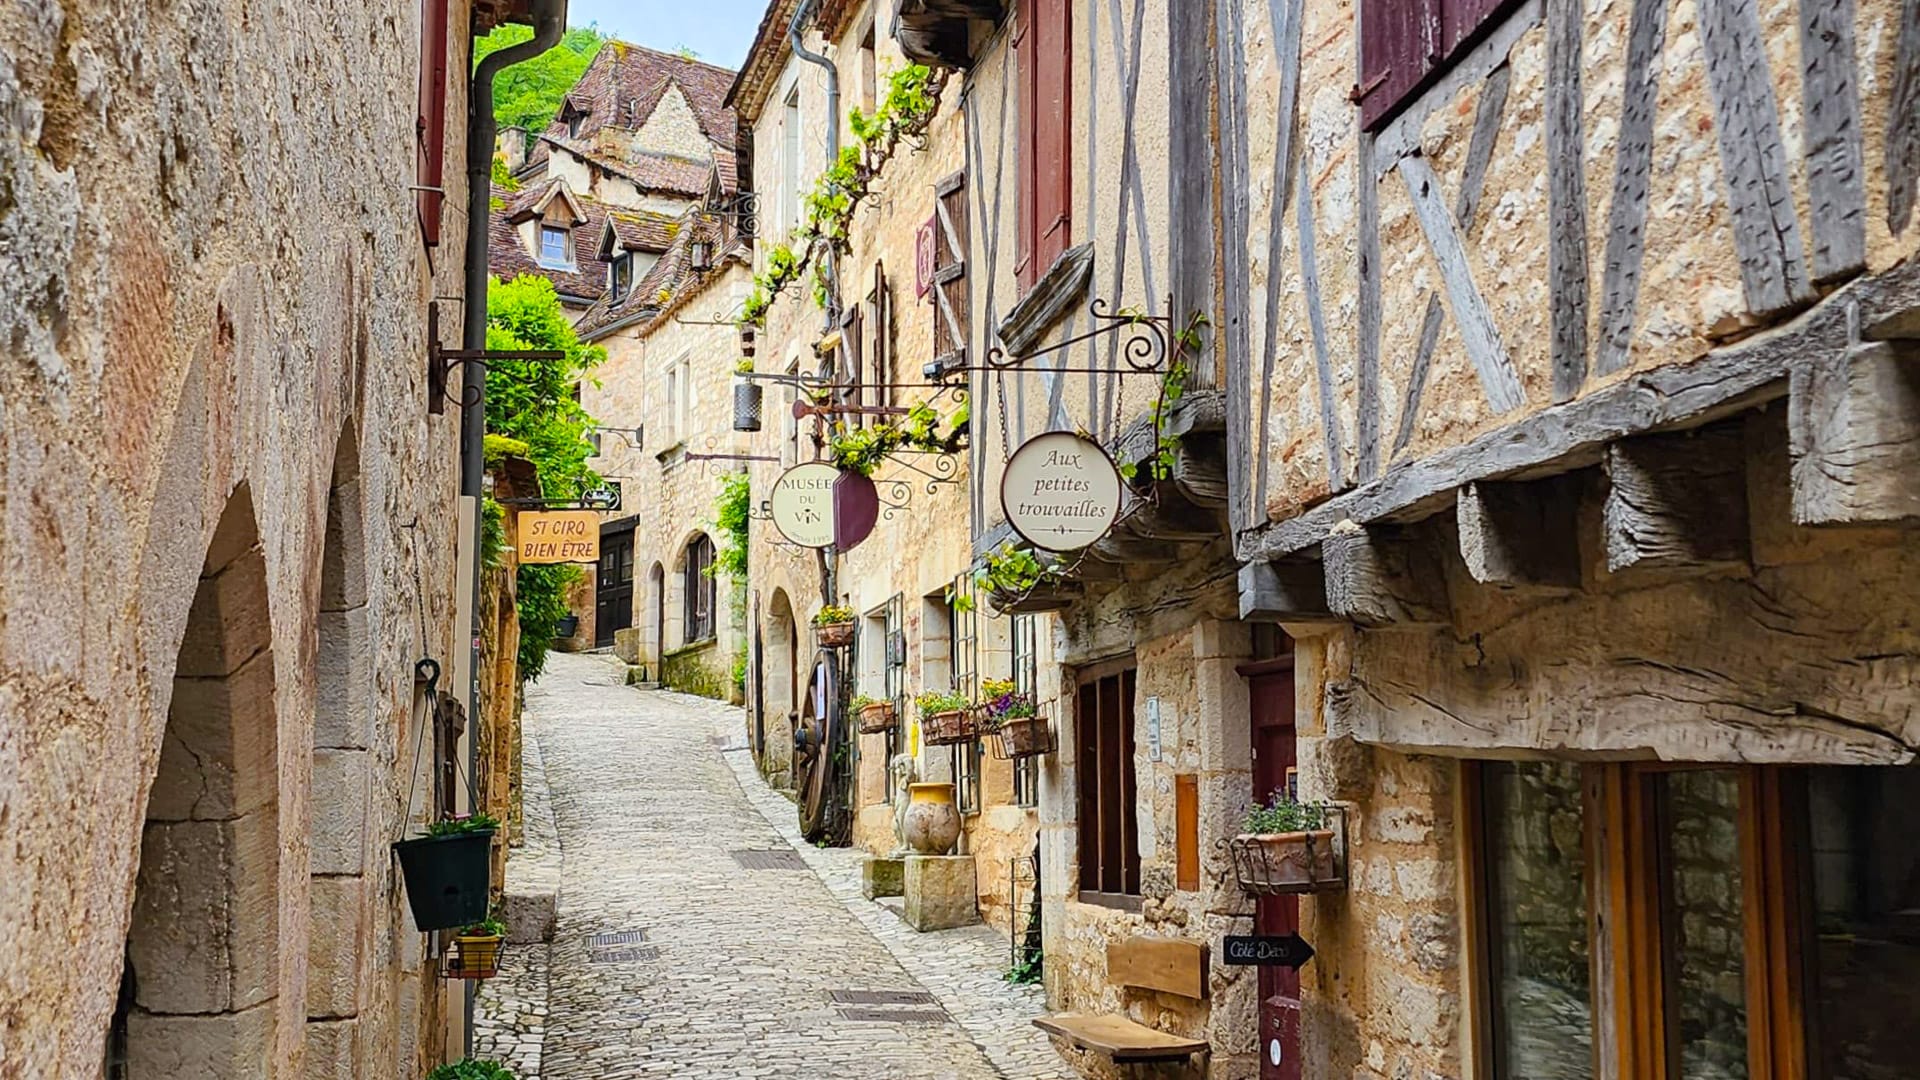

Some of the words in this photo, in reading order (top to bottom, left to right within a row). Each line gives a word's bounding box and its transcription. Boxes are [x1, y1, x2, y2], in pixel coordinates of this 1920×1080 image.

[1041, 450, 1083, 469] Aux
[1033, 475, 1090, 496] petites
[799, 495, 816, 505] DU
[1018, 499, 1107, 518] trouvailles
[532, 520, 549, 536] ST
[552, 520, 586, 537] CIRQ
[524, 543, 558, 558] BIEN
[561, 539, 594, 557] ÊTRE
